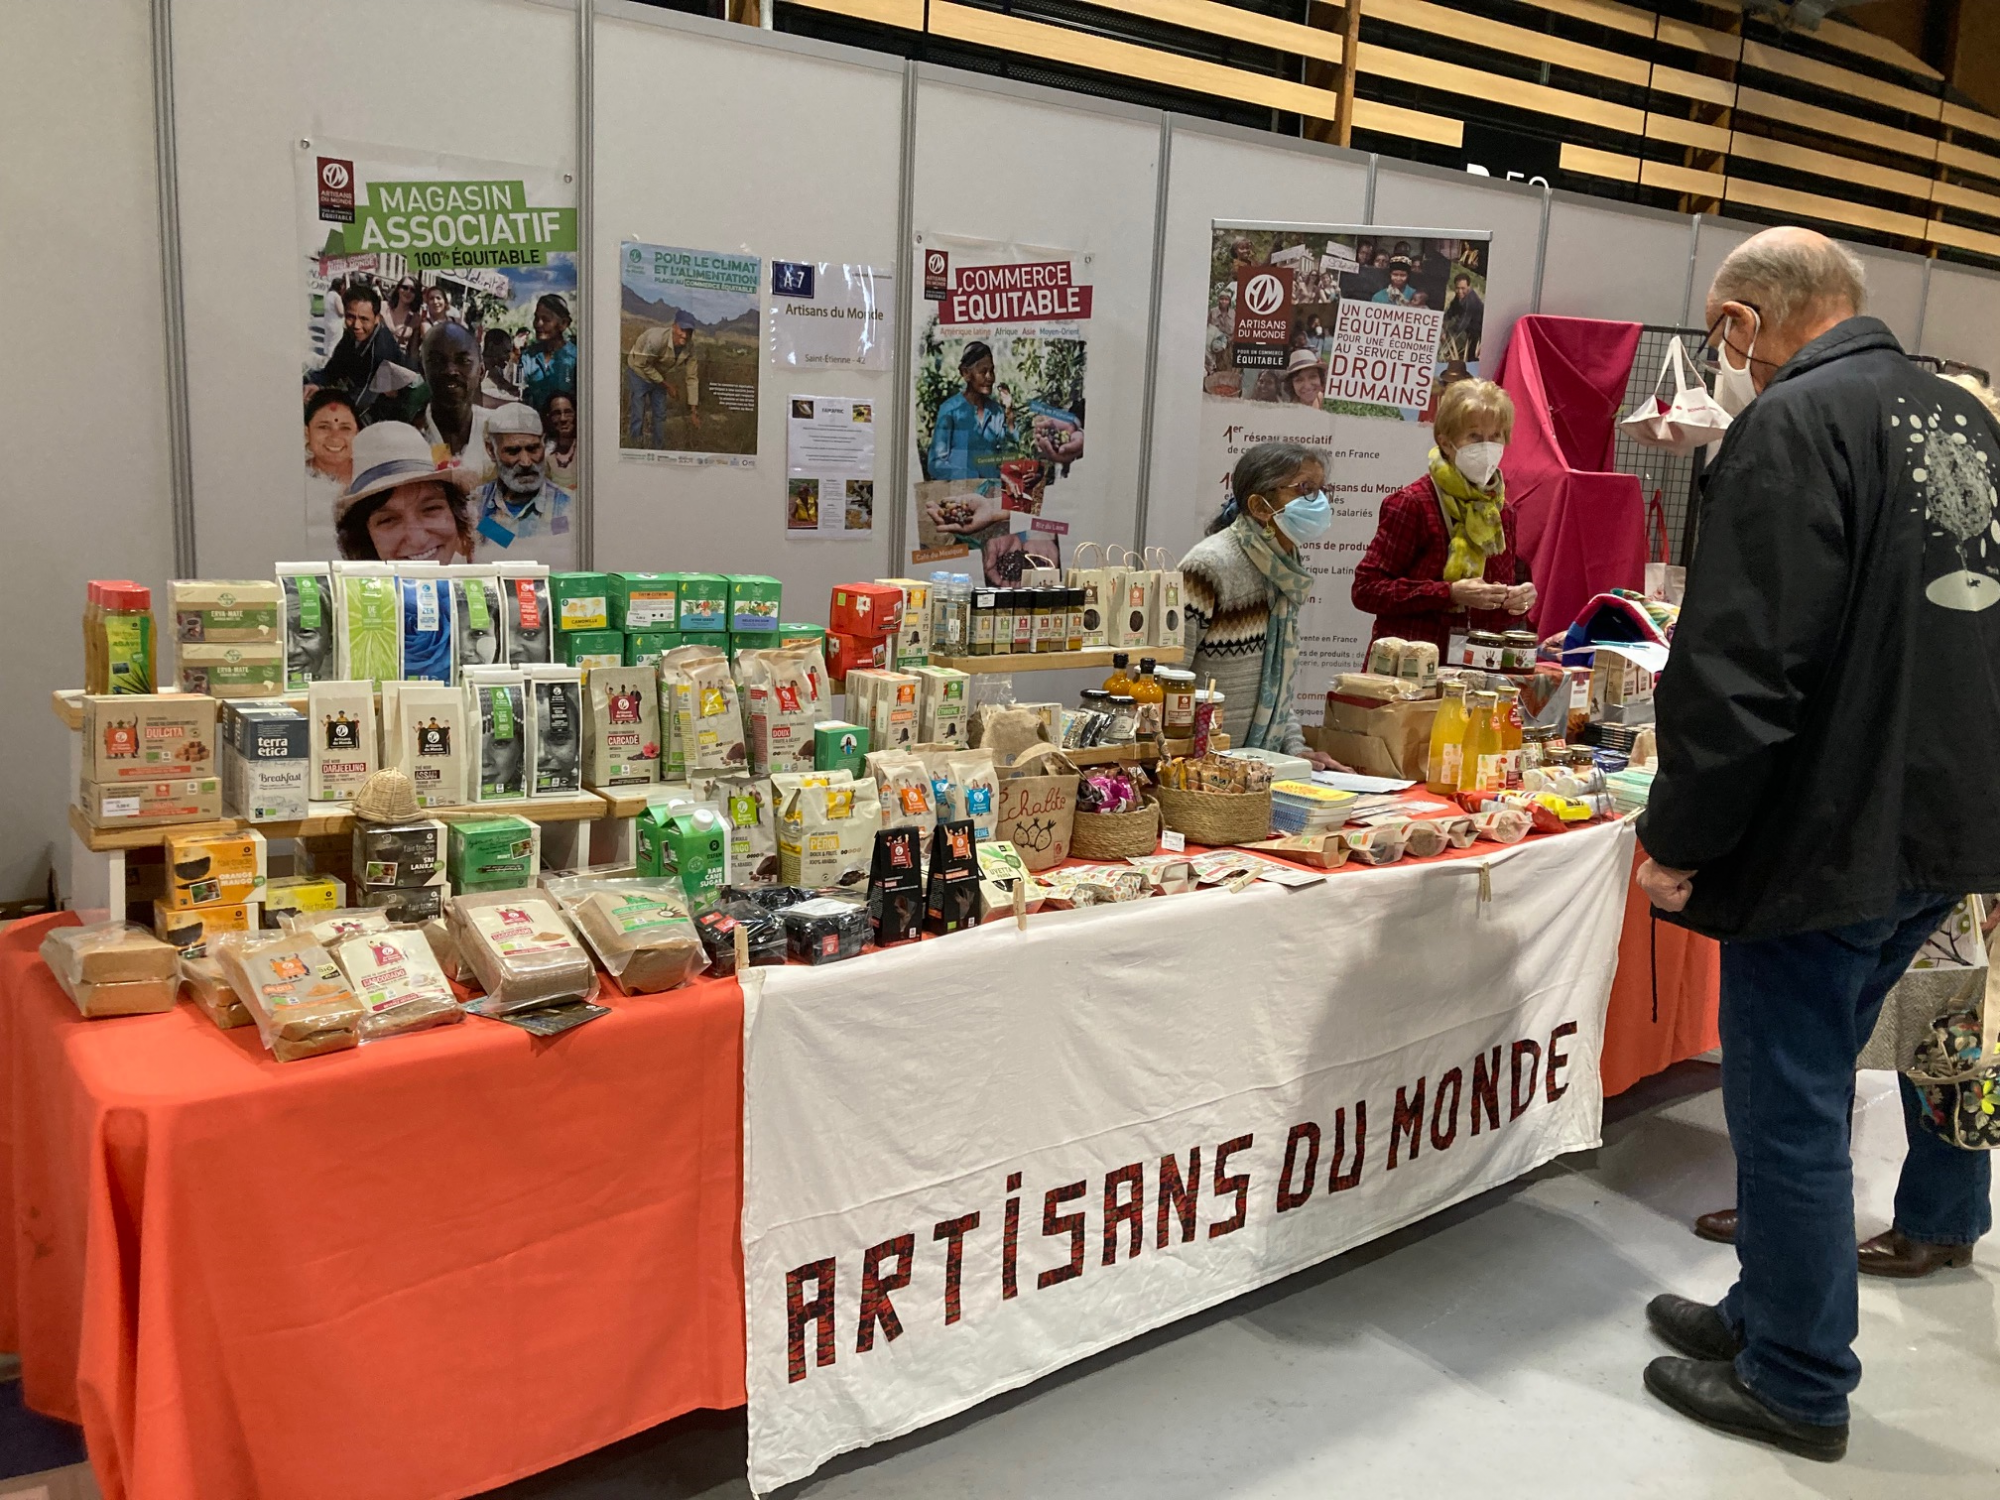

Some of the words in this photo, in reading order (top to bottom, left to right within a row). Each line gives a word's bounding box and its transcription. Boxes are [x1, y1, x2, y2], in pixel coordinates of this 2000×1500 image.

[379, 185, 512, 213] MAGASIN
[361, 212, 560, 250] ASSOCIATIF
[414, 251, 450, 267] 100%
[451, 247, 540, 266] ÉQUITABLE
[654, 252, 690, 267] POUR
[694, 256, 709, 268] LE
[712, 259, 757, 274] CLIMAT
[654, 265, 668, 275] ET
[962, 265, 1068, 292] COMMERCE
[953, 288, 1080, 322] ÉQUITABLE
[785, 303, 828, 318] Artisans
[830, 306, 844, 318] du
[847, 307, 884, 321] Monde
[1341, 304, 1360, 317] UN
[1365, 307, 1439, 328] COMMERCE
[1238, 319, 1287, 330] ARTISANS
[940, 327, 972, 337] Amérique
[994, 328, 1018, 337] Afrique
[1022, 328, 1036, 336] Asie
[1039, 327, 1080, 337] Moyen-Orient
[1238, 329, 1250, 338] DU
[1253, 330, 1286, 339] MONDE
[1337, 333, 1361, 343] POUR
[1366, 337, 1384, 346] UNE
[1389, 338, 1435, 353] ÉCONOMIE
[804, 353, 851, 365] Saint-Étienne
[857, 355, 866, 365] 42
[1334, 343, 1351, 353] AU
[1356, 345, 1405, 361] SERVICE
[1410, 352, 1433, 364] DES
[1236, 354, 1284, 366] ÉQUITABLE
[1331, 354, 1432, 387] DROITS
[1328, 378, 1428, 407] HUMAINS
[1222, 425, 1244, 443] 1er
[1282, 435, 1333, 445] associatif
[1335, 450, 1347, 458] en
[1348, 449, 1380, 459] France
[1360, 483, 1373, 493] du
[1375, 483, 1403, 494] Mond
[1336, 508, 1373, 518] salariés
[1323, 541, 1336, 550] de
[1332, 635, 1358, 644] France
[1319, 650, 1350, 659] produits
[1321, 659, 1351, 669] produits
[146, 727, 183, 738] DULCITA
[772, 729, 790, 737] DOUX
[257, 736, 288, 747] terra
[608, 734, 638, 745] CARCADÉ
[257, 747, 288, 757] etica
[323, 763, 365, 773] DARJEELING
[258, 773, 302, 784] Breakfast
[810, 837, 837, 850] PÉROU
[410, 863, 434, 871] LANKA
[707, 866, 723, 874] RAW
[990, 866, 1013, 875] UVETTA
[219, 871, 253, 880] ORANGE
[704, 873, 723, 881] CANE
[220, 878, 253, 887] MANGO
[699, 878, 723, 888] SUGAR
[1277, 1100, 1367, 1212] DU
[1386, 1020, 1578, 1171] MONDE
